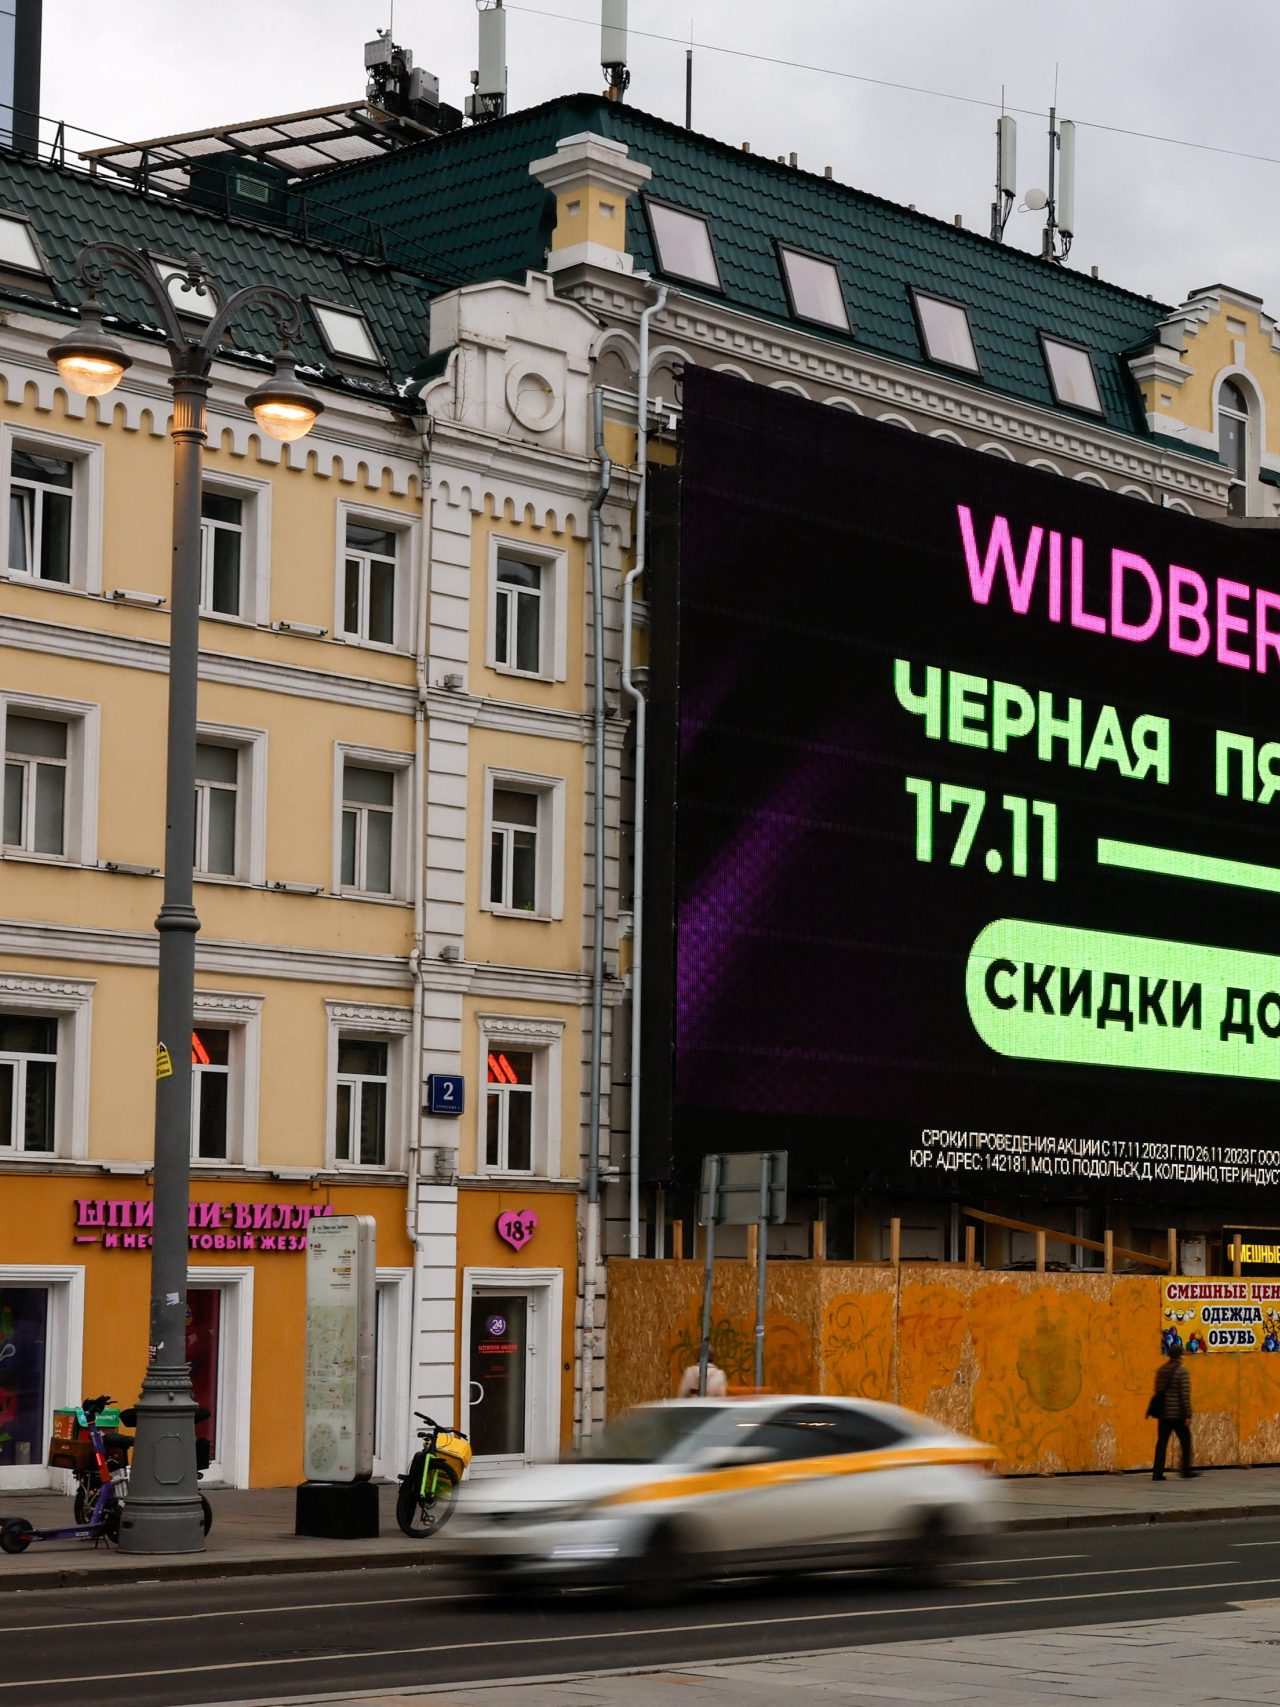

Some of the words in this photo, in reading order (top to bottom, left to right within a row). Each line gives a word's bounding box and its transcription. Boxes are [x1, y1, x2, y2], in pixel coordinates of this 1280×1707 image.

[893, 658, 1171, 785] ЧЕРНАЯ
[905, 778, 1059, 882] 17.11
[984, 958, 1202, 1031] СКИДКИ
[443, 1081, 454, 1101] 2
[921, 1129, 967, 1149] СРОКИ
[969, 1132, 1056, 1154] ПРОВЕДЕНИЯ
[1057, 1137, 1100, 1157] АКЦИИ
[1179, 1145, 1195, 1161] ПО
[1258, 1150, 1280, 1166] ООО
[910, 1150, 933, 1168] ЮР.
[936, 1151, 983, 1171] АДРЕС:
[985, 1154, 1030, 1175] 142181,
[1072, 1159, 1140, 1180] ПОДОЛЬСК,
[1155, 1163, 1218, 1184] КОЛЕДИНО,
[76, 1199, 334, 1229] ШПИИ-ВИЛЛ
[105, 1233, 120, 1248] И
[124, 1231, 256, 1250] НЕТОВЫЙ
[504, 1220, 535, 1242] 18+
[1167, 1284, 1247, 1300] СМЕШНЫЕ
[492, 1319, 503, 1330] 24
[1202, 1307, 1262, 1324] ОДЕЖДА
[1208, 1329, 1255, 1345] ОБУВЬ
